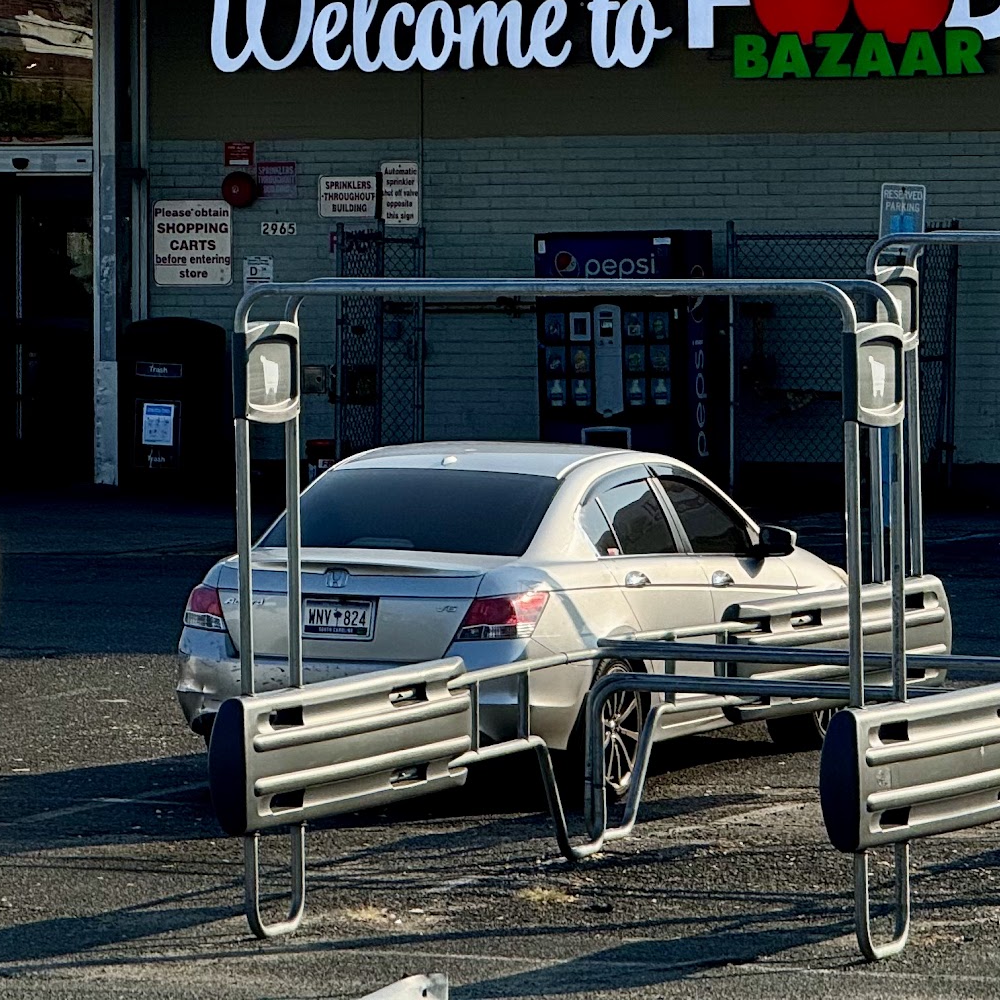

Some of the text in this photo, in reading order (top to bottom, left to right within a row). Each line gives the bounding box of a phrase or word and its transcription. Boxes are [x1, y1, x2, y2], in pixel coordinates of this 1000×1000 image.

[732, 28, 985, 80] BAZAAR
[384, 167, 417, 175] Automatic
[325, 181, 372, 190] SPRINKLERS
[386, 179, 415, 187] sprinkler
[323, 192, 375, 201] THROUGHOUT
[883, 189, 923, 201] RESERVED
[332, 203, 367, 213] BUILDING
[386, 200, 413, 208] opposite
[885, 201, 920, 213] PARKING
[154, 207, 229, 217] Please obtain
[400, 212, 414, 220] sign
[156, 222, 229, 234] SHOPPING
[262, 222, 296, 235] 2965
[169, 239, 217, 251] CARTS
[155, 253, 231, 266] before entering
[584, 252, 656, 279] pepsi
[179, 268, 208, 278] store
[250, 266, 258, 276] D
[149, 365, 169, 374] Trash
[691, 339, 710, 457] pepsi
[308, 608, 366, 627] WNV 824
